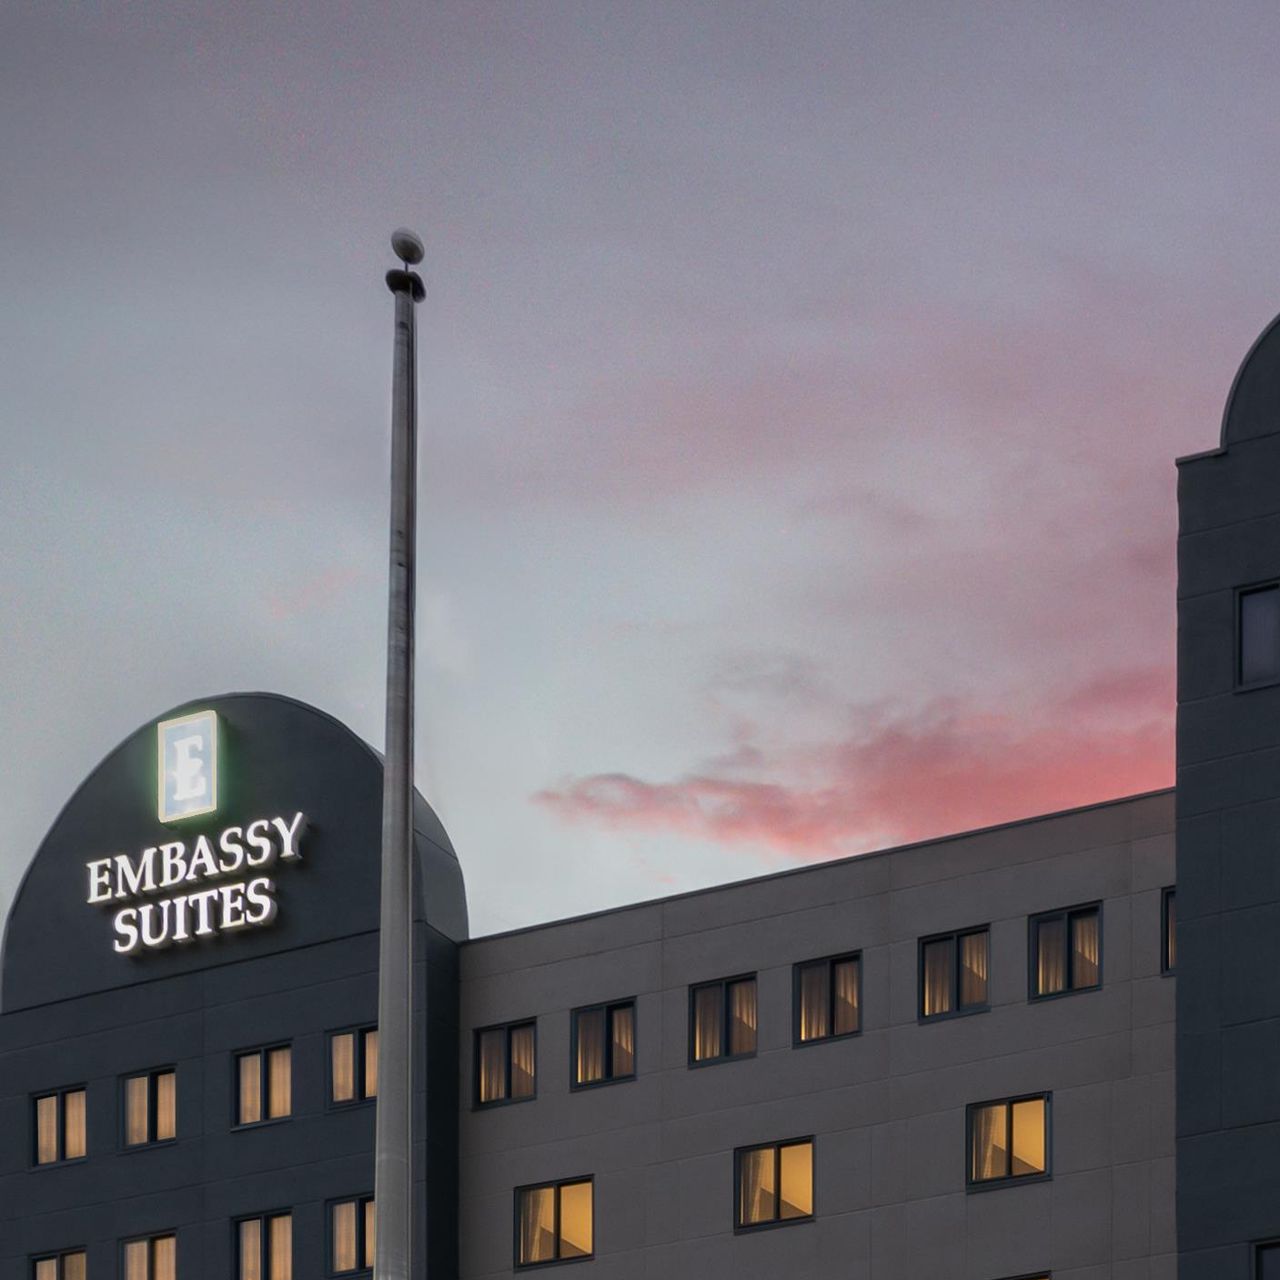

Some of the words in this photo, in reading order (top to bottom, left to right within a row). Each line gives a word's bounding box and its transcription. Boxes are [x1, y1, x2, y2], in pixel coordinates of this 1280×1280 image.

[173, 736, 206, 801] E
[86, 812, 304, 904] EMBASSY
[113, 878, 274, 953] SUITES
